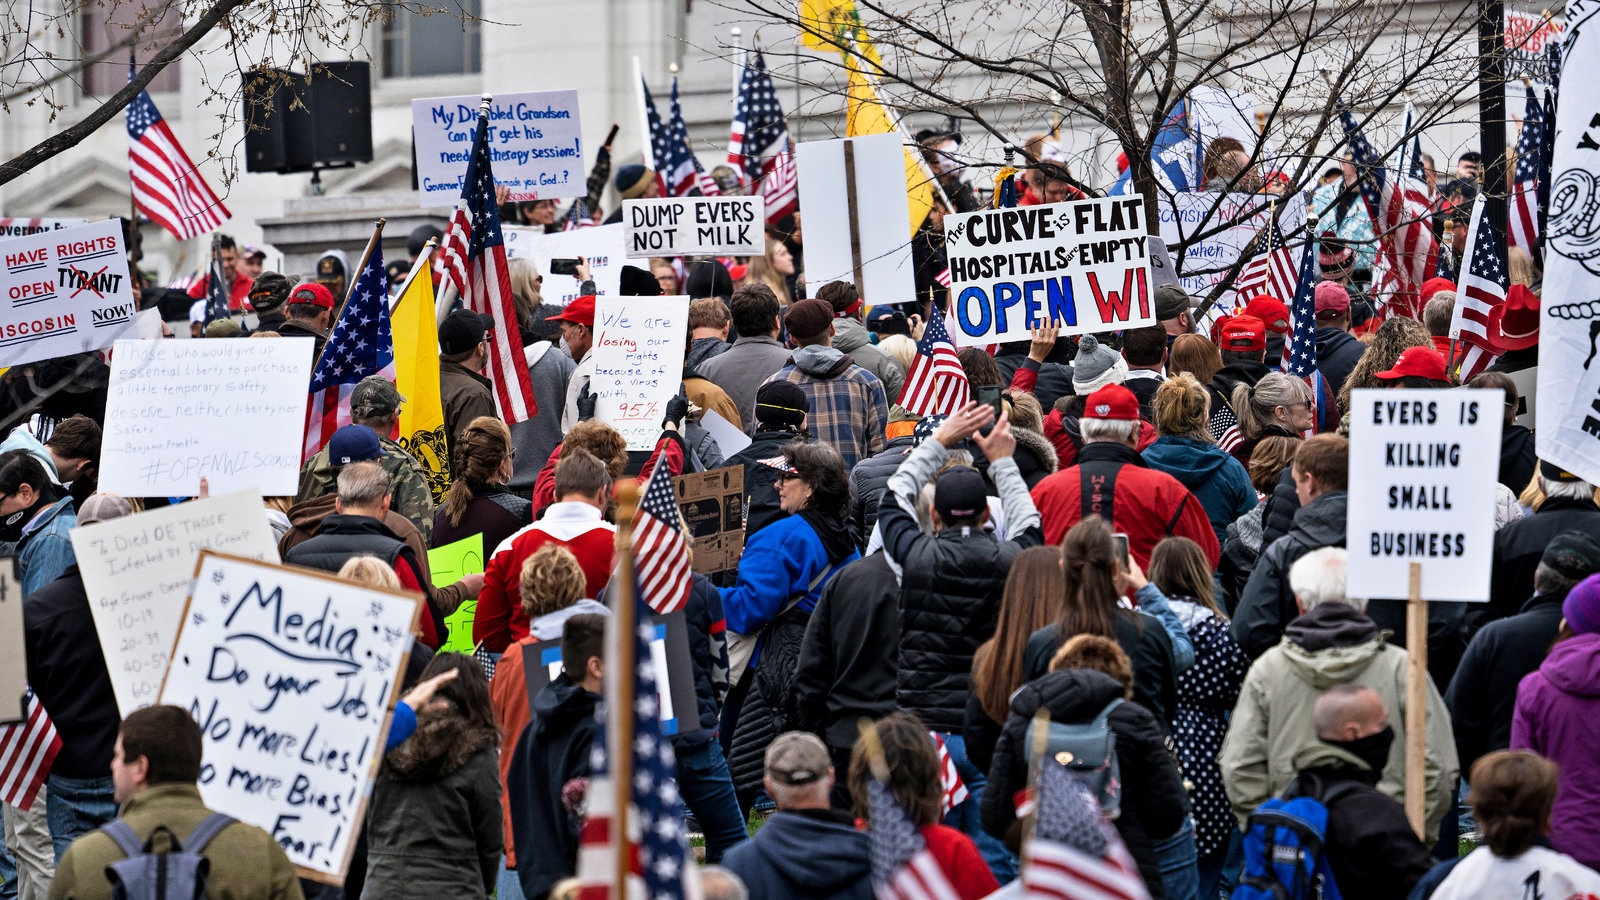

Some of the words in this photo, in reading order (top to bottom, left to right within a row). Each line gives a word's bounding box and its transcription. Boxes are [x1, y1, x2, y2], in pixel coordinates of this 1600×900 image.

[432, 105, 454, 130] My
[457, 103, 513, 123] Disbled
[516, 102, 570, 121] Grandson
[448, 131, 467, 142] can
[500, 125, 521, 144] get
[525, 124, 543, 139] his
[490, 146, 529, 166] therapy
[532, 138, 581, 158] sessions!
[424, 177, 459, 192] Governor
[524, 179, 537, 190] you
[632, 203, 684, 228] DUMP
[695, 201, 754, 223] EVERS
[946, 221, 966, 247] The
[966, 207, 1055, 247] CURVE
[1053, 212, 1071, 231] is
[1074, 199, 1142, 235] FLAT
[0, 225, 50, 237] overnor
[634, 229, 677, 251] NOT
[698, 224, 752, 246] MILK
[6, 248, 48, 267] HAVE
[57, 236, 116, 257] RIGHTS
[950, 246, 1069, 282] HOSPITALS
[1066, 246, 1079, 262] are
[1079, 236, 1147, 266] EMPTY
[1188, 241, 1224, 258] when
[9, 280, 55, 300] OPEN
[58, 268, 122, 294] TYRANT
[91, 303, 133, 321] NOW!
[957, 275, 1077, 337] OPEN
[1086, 267, 1150, 323] WI
[0, 313, 75, 339] ISCOSIN
[602, 307, 631, 328] We
[645, 317, 672, 329] are
[120, 341, 166, 361] Those
[174, 345, 198, 359] who
[202, 345, 234, 358] would
[262, 345, 275, 358] up
[598, 331, 637, 352] losing
[647, 338, 670, 346] our
[119, 365, 180, 380] essential
[229, 365, 240, 375] to
[244, 362, 299, 376] purchase
[595, 364, 642, 375] because
[652, 364, 667, 375] of
[626, 352, 658, 366] rights
[127, 383, 158, 395] little
[162, 382, 220, 398] temporary
[600, 389, 627, 399] with
[630, 378, 658, 387] virus
[110, 405, 171, 419] deserve
[175, 402, 231, 418] neither
[619, 400, 659, 418] 95%
[1373, 401, 1437, 425] EVERS
[1460, 401, 1479, 425] IS
[1386, 443, 1460, 467] KILLING
[1389, 485, 1452, 510] SMALL
[114, 528, 148, 553] Died
[1371, 532, 1465, 557] BUSINESS
[225, 581, 358, 663] Media
[207, 647, 248, 684] Do
[250, 671, 320, 713] your
[322, 671, 389, 724] Job!
[191, 697, 232, 741] No
[238, 720, 298, 758] more
[300, 723, 369, 782] Lies!
[200, 763, 216, 784] o
[228, 767, 283, 799] more
[286, 774, 356, 823] Bias!
